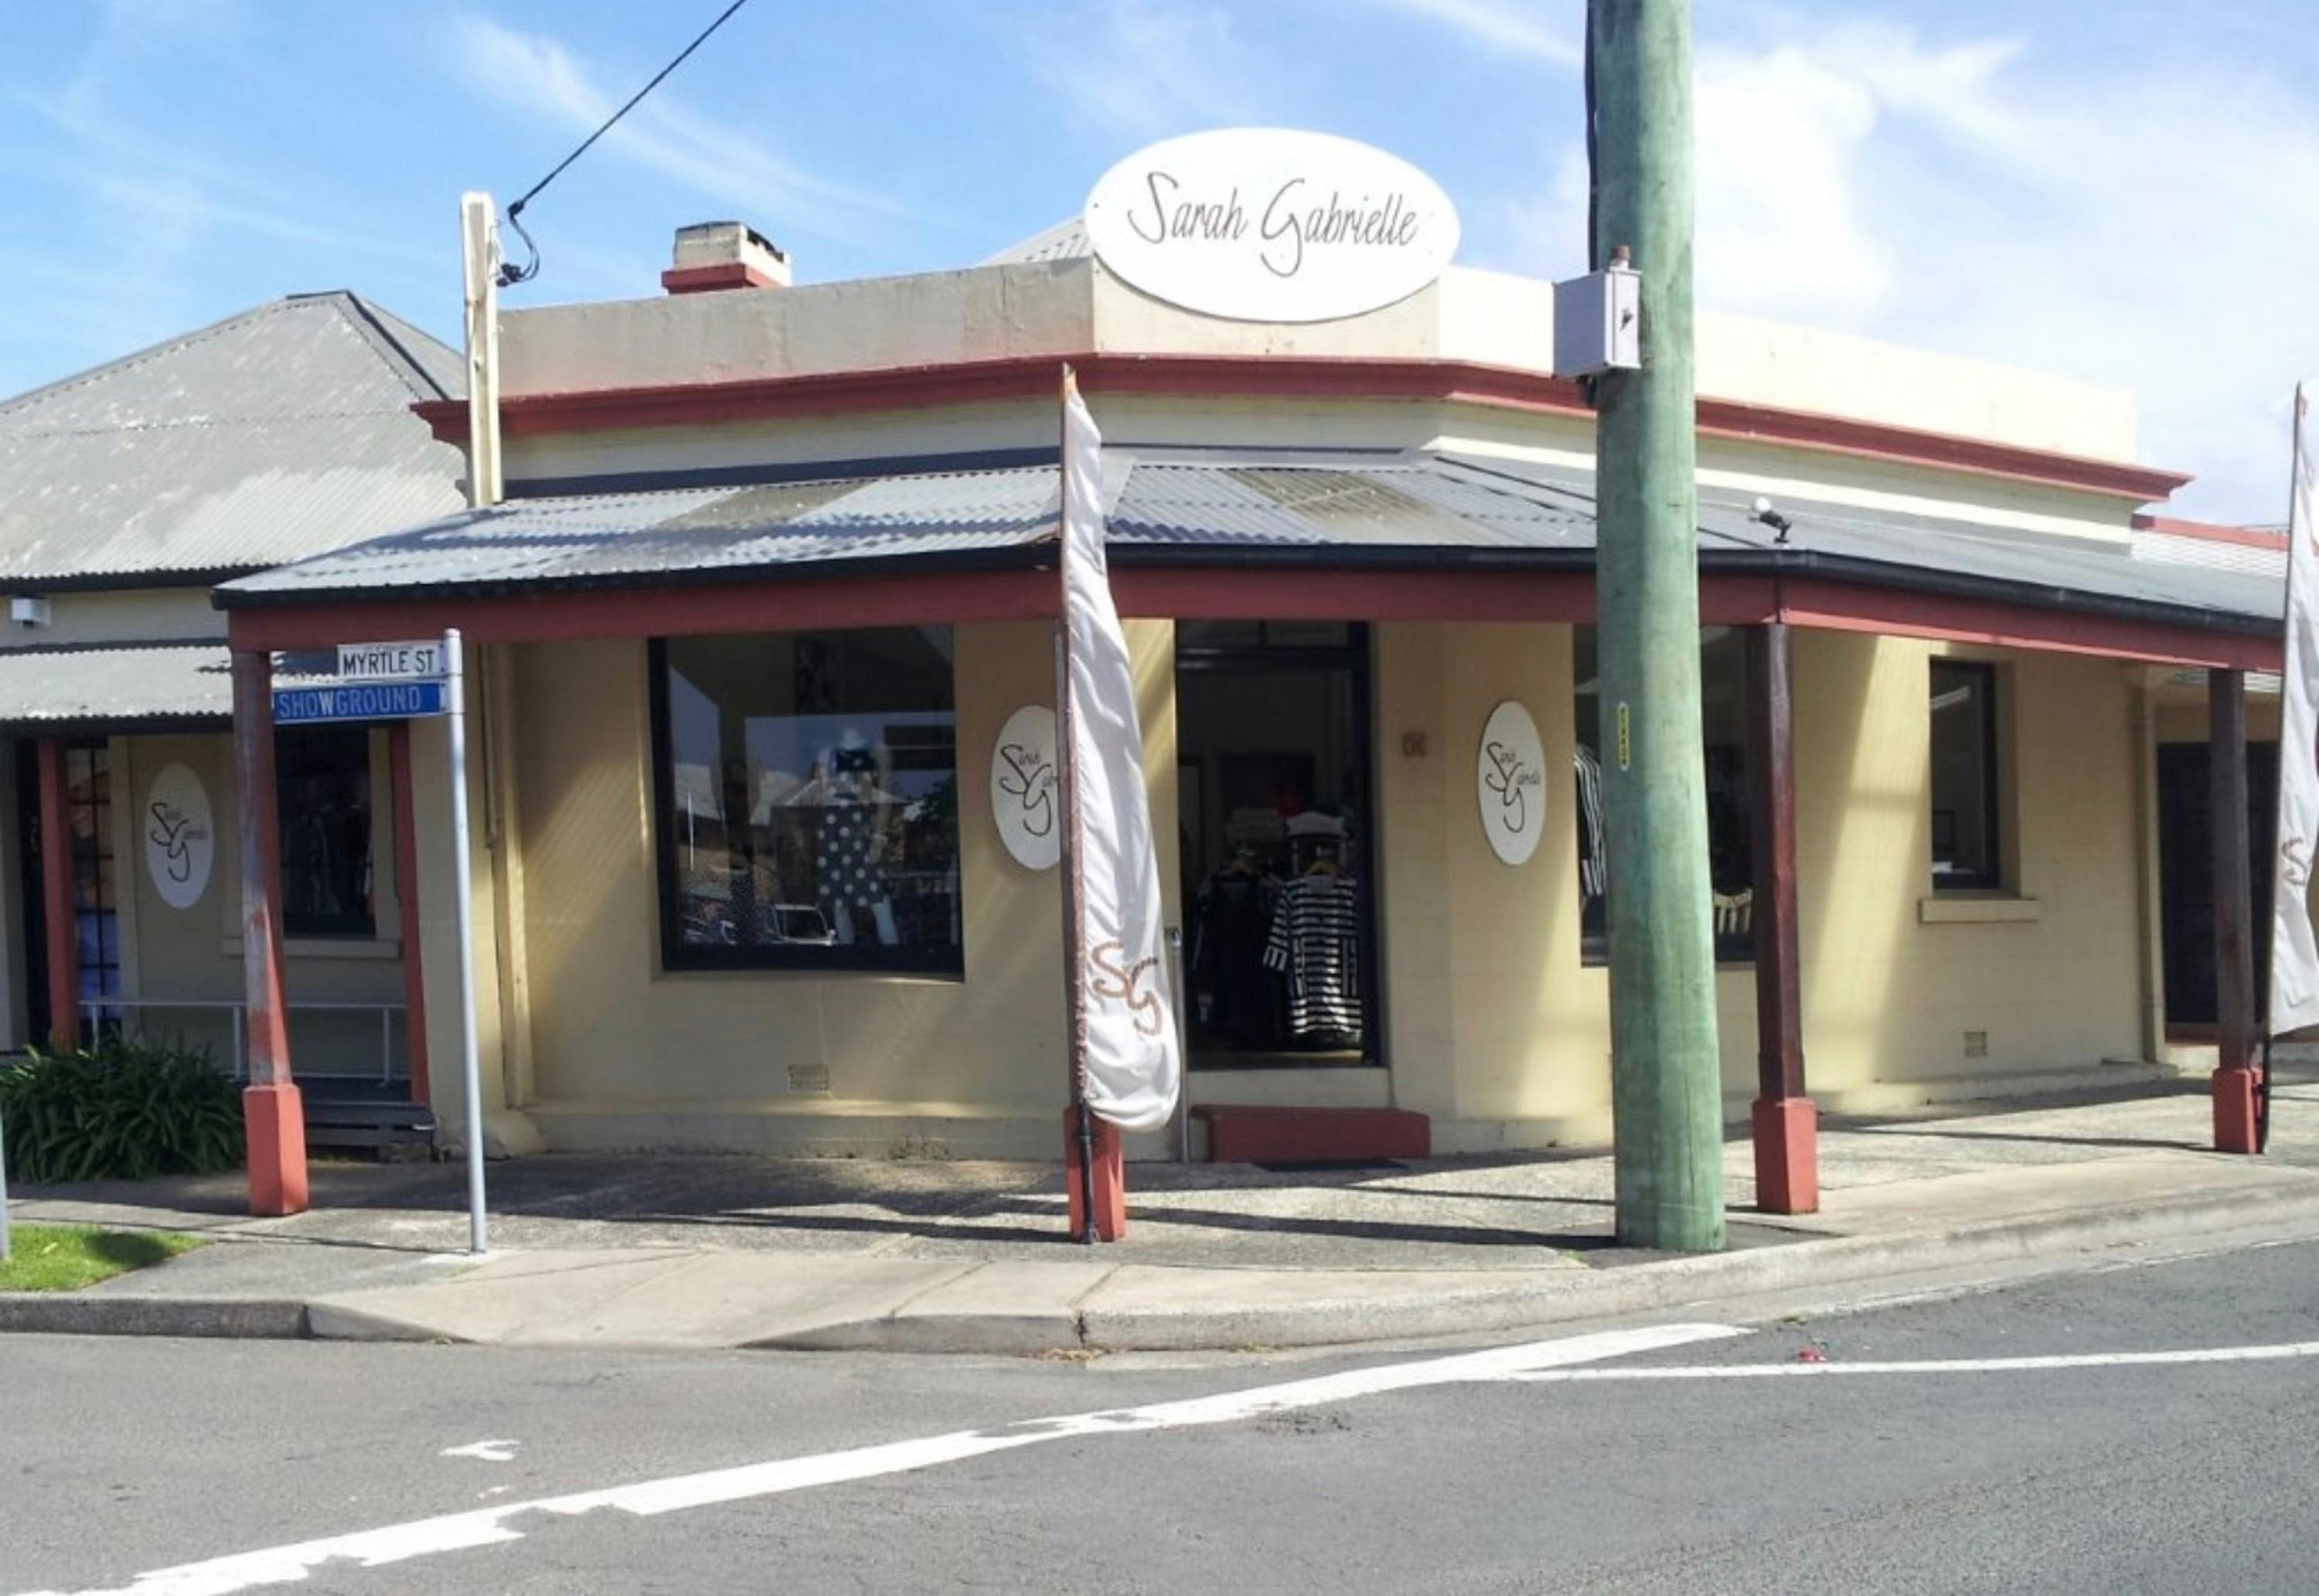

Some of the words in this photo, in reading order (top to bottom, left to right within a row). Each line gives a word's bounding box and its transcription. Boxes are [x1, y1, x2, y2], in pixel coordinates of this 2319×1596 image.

[1128, 172, 1248, 243] Sarah
[1261, 178, 1418, 277] Gabrielle
[343, 651, 409, 675] MYRTLE
[414, 649, 434, 672] ST
[279, 686, 421, 718] SHOWGROUND
